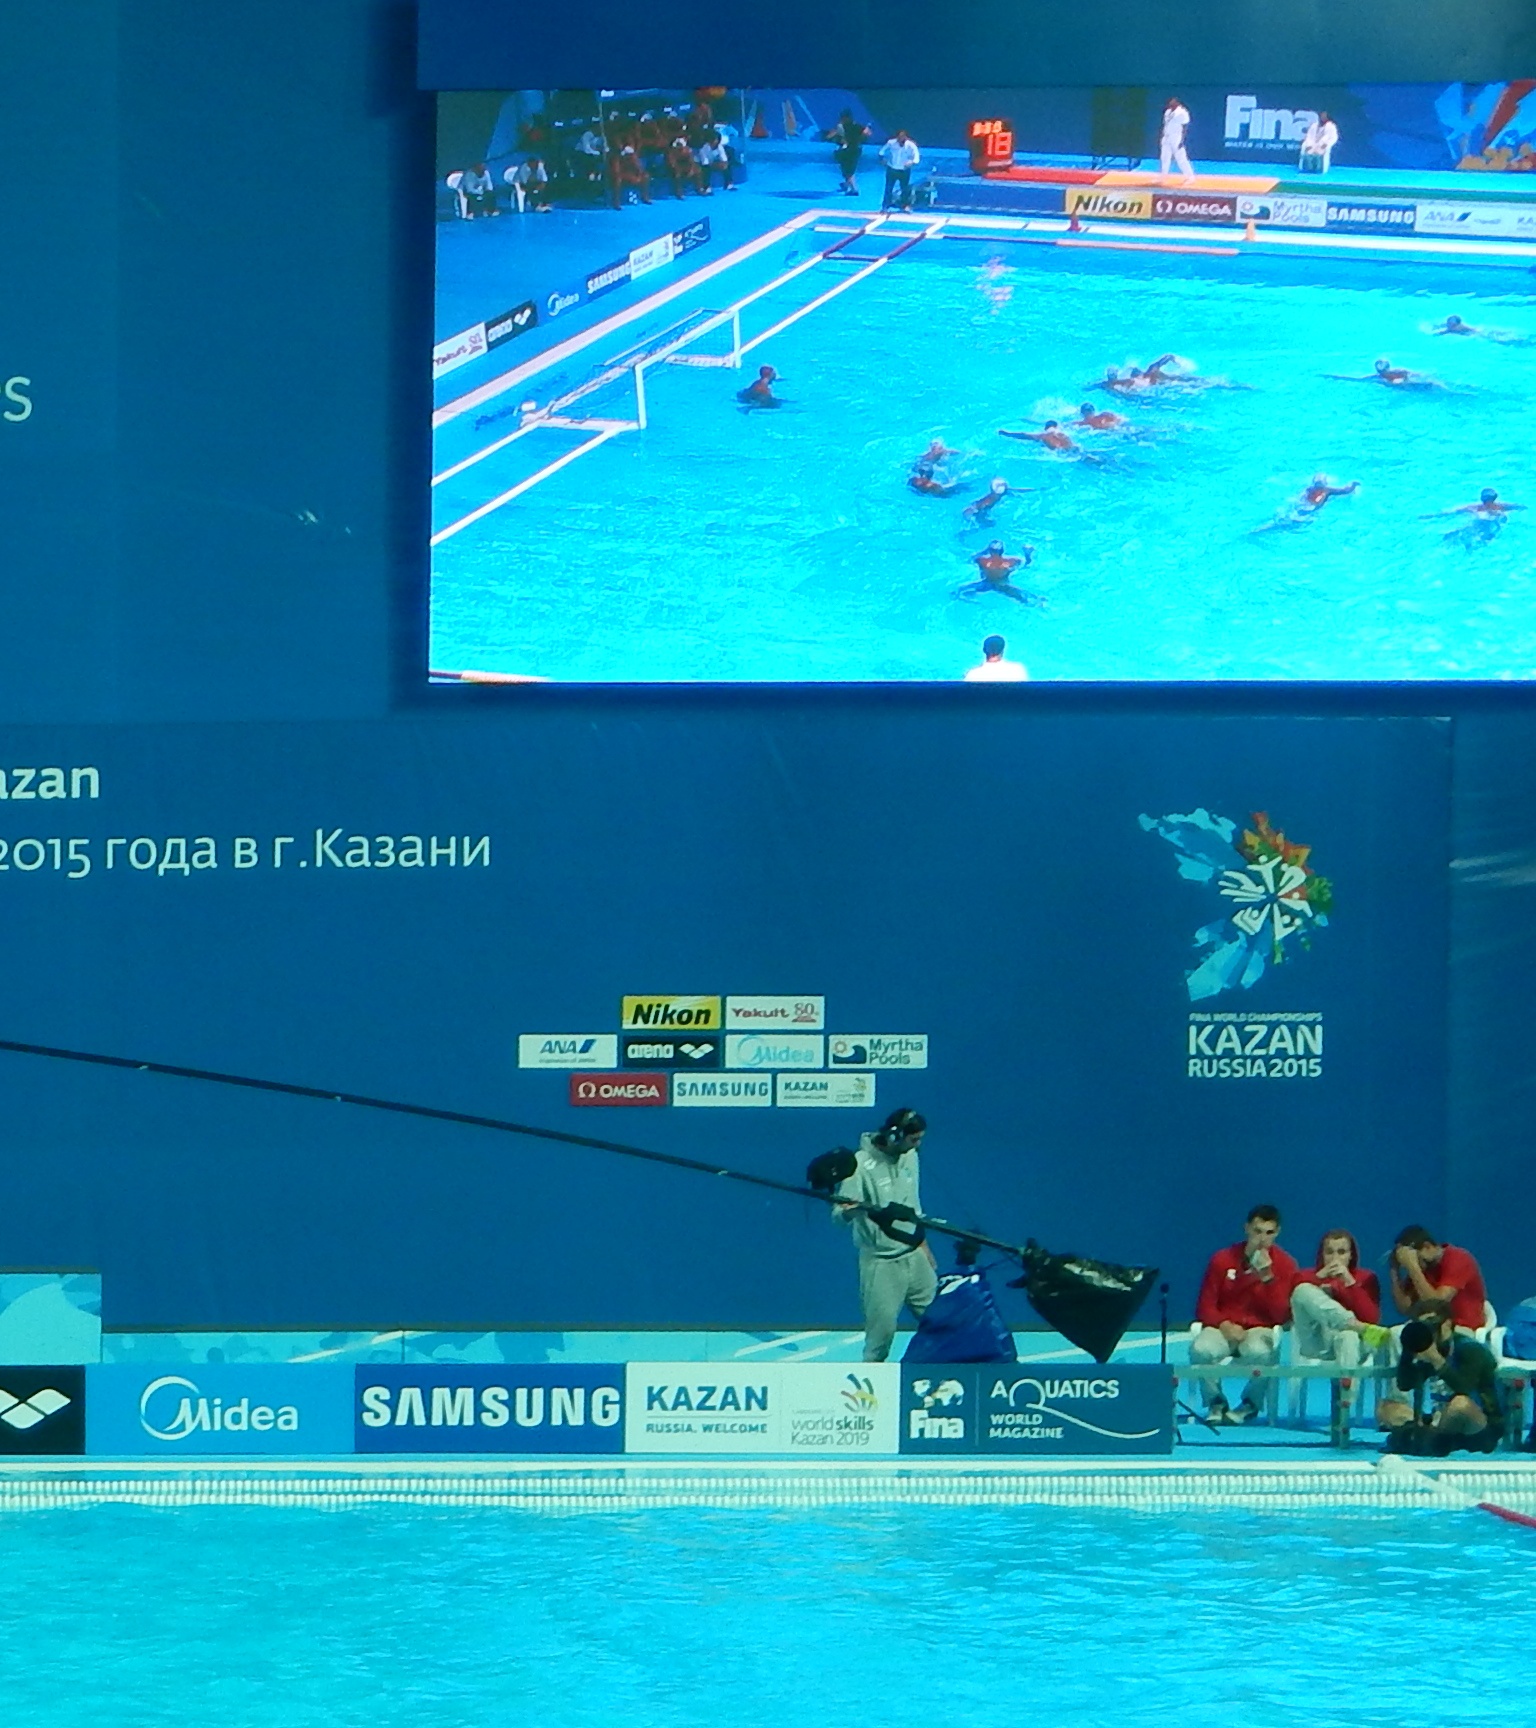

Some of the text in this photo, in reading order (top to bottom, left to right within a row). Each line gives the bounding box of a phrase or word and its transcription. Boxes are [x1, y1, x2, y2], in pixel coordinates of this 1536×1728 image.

[1074, 195, 1144, 215] Nikon
[1176, 202, 1232, 216] OMEGA
[1327, 206, 1414, 224] SAMSUNG
[104, 837, 218, 876] года
[234, 836, 260, 870] в
[632, 1004, 711, 1025] Nikon
[732, 1007, 788, 1018] Yakult
[540, 1040, 578, 1053] ANA
[869, 1038, 923, 1053] Myrtha
[1188, 1024, 1323, 1055] KAZAN
[628, 1043, 673, 1059] arena
[869, 1052, 910, 1064] Pools
[1188, 1058, 1322, 1078] RUSSIA 2015
[600, 1084, 660, 1098] OMEGA
[677, 1081, 768, 1096] SAMSUNG
[784, 1081, 828, 1091] KAZAN
[646, 1384, 769, 1412] KAZAN
[991, 1378, 1120, 1409] AQUATICS
[361, 1385, 622, 1428] SAMSUNG
[167, 1395, 299, 1435] Midea
[991, 1413, 1043, 1426] WORLD
[646, 1423, 768, 1434] RUSSIA. WELCOME
[910, 1411, 965, 1440] Fina
[989, 1426, 1065, 1440] MAGAZINE
[791, 1431, 870, 1446] Kazan 2019
